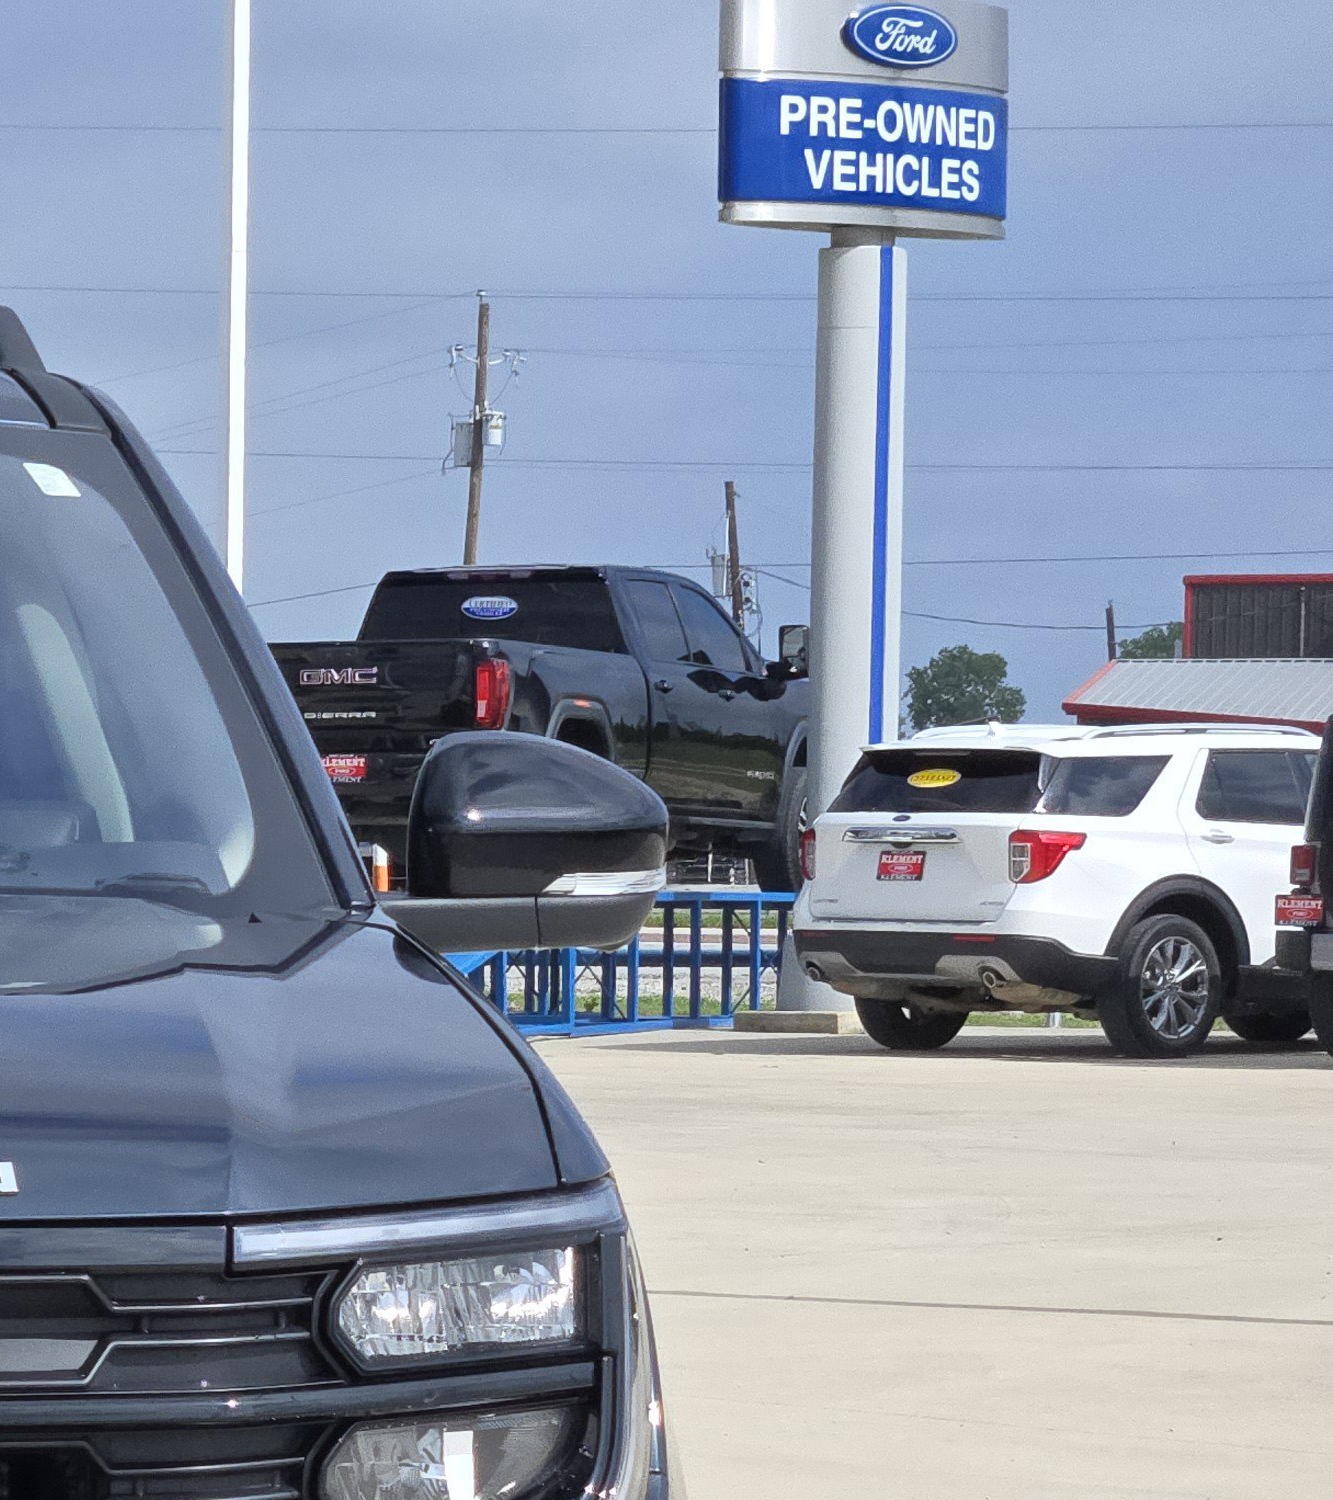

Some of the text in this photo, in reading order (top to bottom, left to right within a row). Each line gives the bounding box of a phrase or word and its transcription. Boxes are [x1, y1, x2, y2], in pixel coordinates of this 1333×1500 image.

[875, 17, 938, 55] Ford
[780, 95, 995, 151] PRE-OWNED
[804, 149, 981, 201] VEHICLES
[300, 667, 378, 685] GMC
